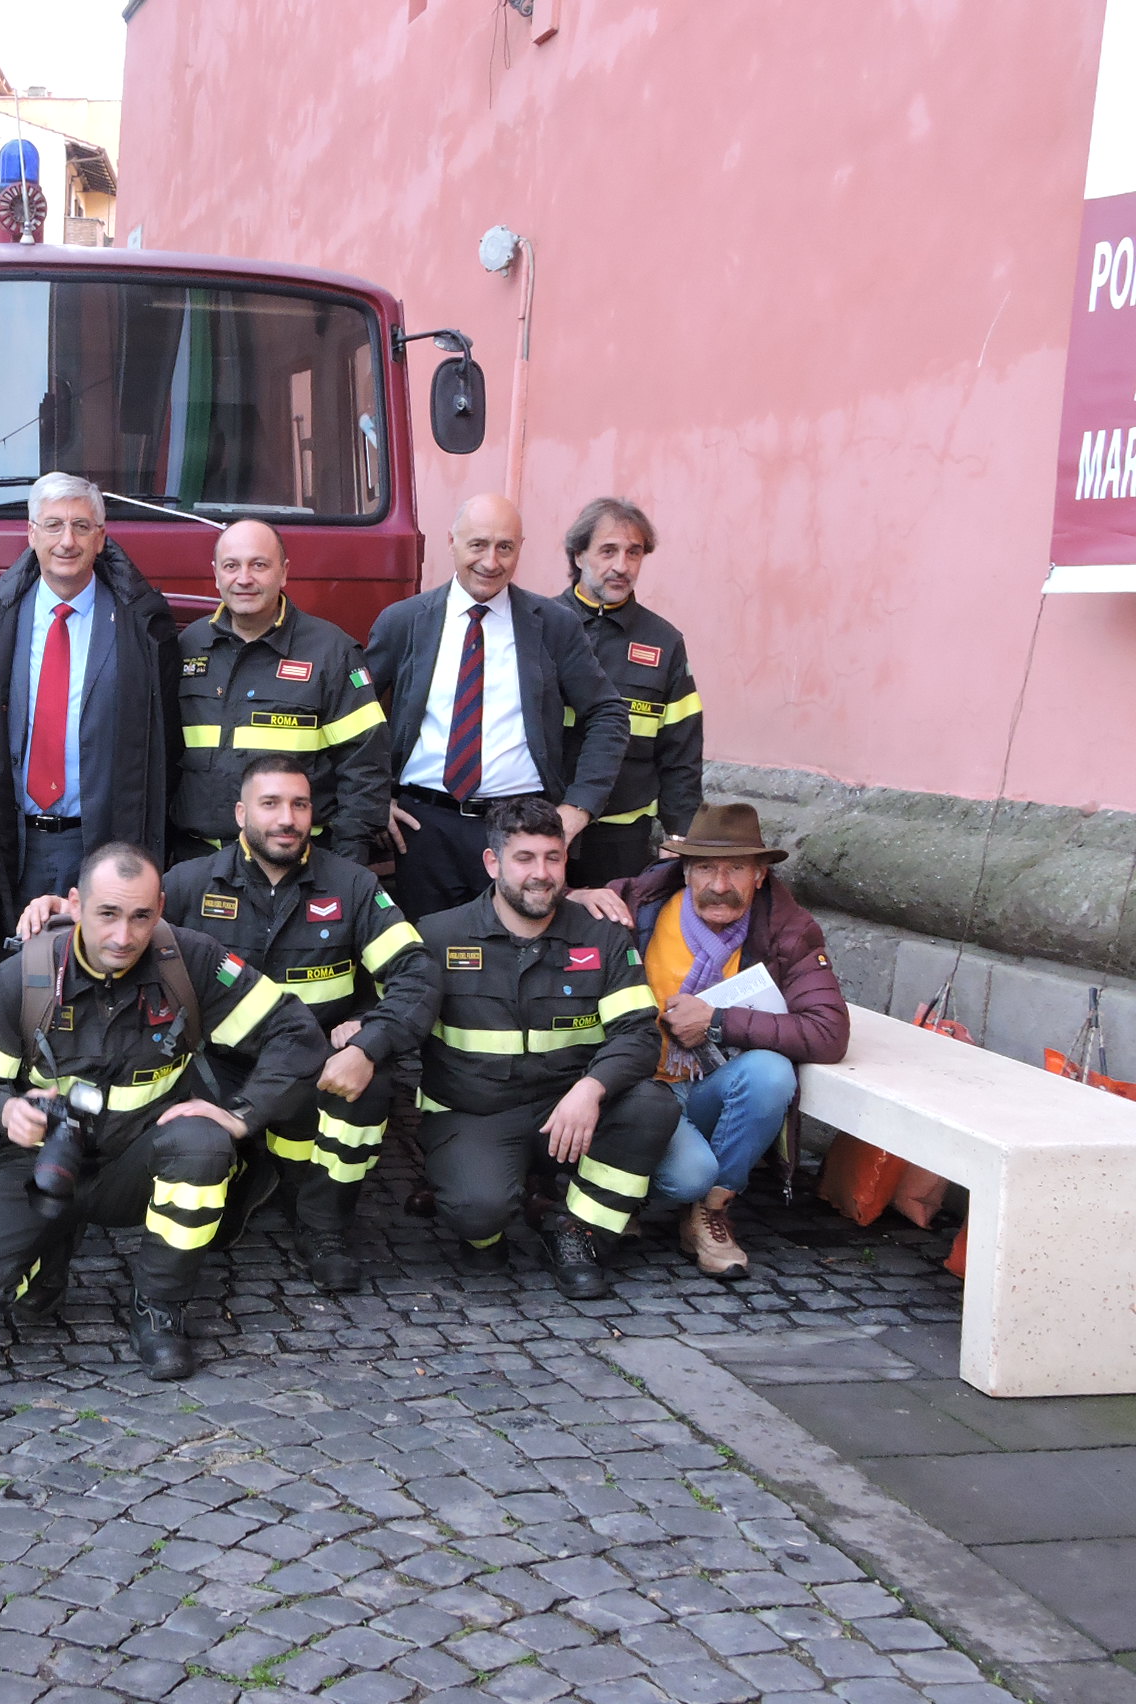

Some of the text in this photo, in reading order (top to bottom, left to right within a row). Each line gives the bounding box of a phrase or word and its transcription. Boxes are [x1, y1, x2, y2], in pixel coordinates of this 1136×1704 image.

[1088, 236, 1136, 312] PO
[630, 701, 652, 712] ROMA
[270, 715, 298, 726] ROMA
[307, 966, 335, 980] ROMA
[572, 1015, 597, 1027] ROMA
